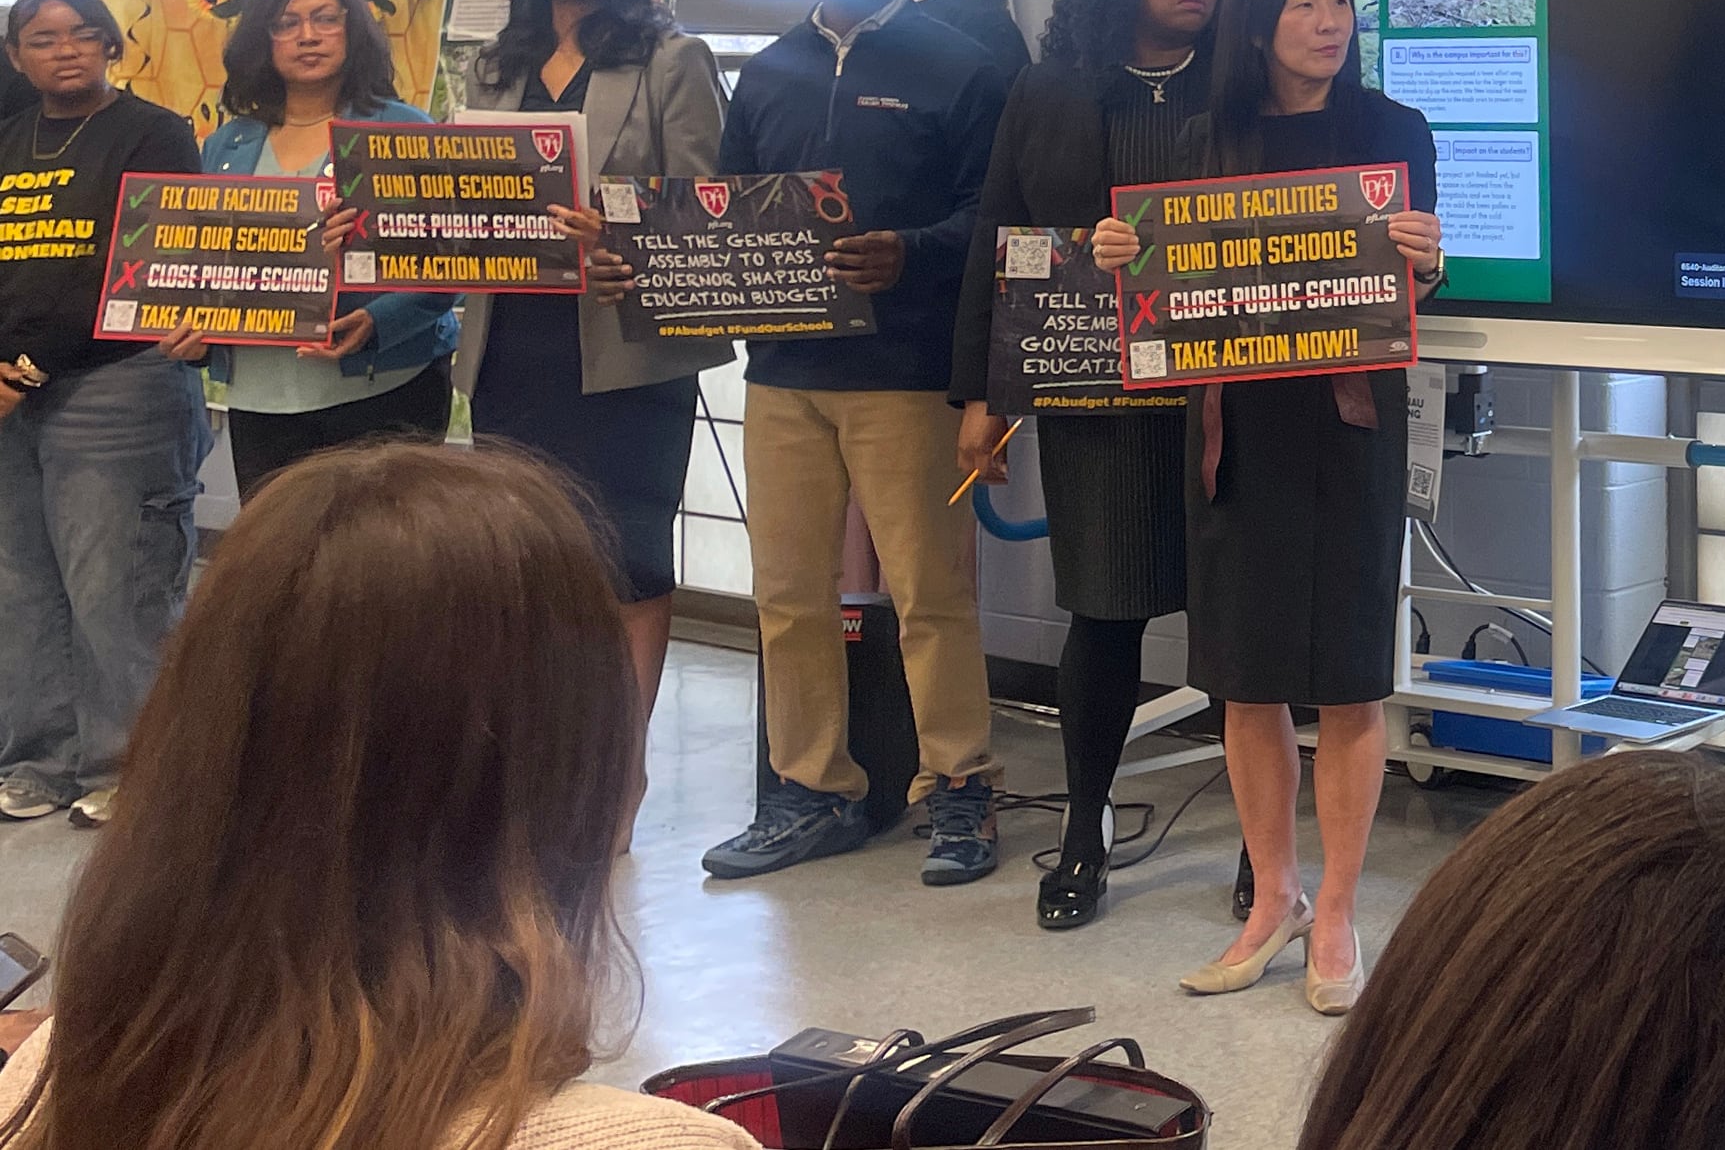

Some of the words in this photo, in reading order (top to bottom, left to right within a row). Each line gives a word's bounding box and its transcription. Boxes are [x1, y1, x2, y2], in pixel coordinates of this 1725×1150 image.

[368, 134, 393, 159] FIX
[395, 135, 430, 160] OUR
[433, 136, 517, 160] FACILITIES
[0, 169, 75, 192] DON'T
[372, 173, 417, 199] FUND
[420, 173, 456, 200] OUR
[458, 175, 535, 200] SCHOOLS
[0, 194, 53, 215] SELL
[160, 186, 184, 210] FIX
[186, 186, 220, 211] OUR
[223, 188, 299, 213] FACILITIES
[1163, 195, 1191, 226] FIX
[1196, 192, 1236, 222] OUR
[1242, 183, 1338, 220] FACILITIES
[0, 218, 96, 242] KENAU
[377, 213, 426, 239] CLOSE
[430, 214, 489, 239] PUBLIC
[154, 225, 198, 249] FUND
[199, 226, 233, 251] OUR
[236, 228, 307, 253] SCHOOLS
[632, 234, 680, 251] TELL
[683, 234, 720, 250] THE
[726, 229, 820, 248] GENERAL
[1166, 241, 1217, 273] FUND
[1221, 237, 1262, 269] OUR
[1267, 229, 1358, 265] SCHOOLS
[379, 255, 418, 280] TAKE
[422, 256, 480, 281] ACTION
[484, 256, 538, 281] NOW!!
[647, 252, 733, 269] ASSEMBLY
[739, 252, 766, 267] TO
[772, 249, 815, 266] PASS
[147, 263, 198, 289] CLOSE
[200, 265, 258, 291] PUBLIC
[259, 267, 329, 293] SCHOOLS
[633, 270, 737, 289] GOVERNOR
[742, 266, 830, 287] SHAPIRO'
[1681, 275, 1720, 287] Session
[640, 290, 746, 309] EDUCATION
[750, 285, 838, 305] BUDGET!
[1034, 293, 1086, 310] TELL
[1095, 293, 1119, 309] TH
[1168, 288, 1228, 321] CLOSE
[1232, 281, 1302, 316] PUBLIC
[1305, 273, 1398, 310] SCHOOLS
[140, 304, 180, 330] TAKE
[182, 306, 242, 333] ACTION
[243, 309, 296, 334] NOW!!
[659, 324, 725, 338] #PAbudget
[727, 320, 834, 335] #FundOurSchools
[1043, 315, 1119, 332] ASSEMB
[1020, 335, 1122, 354] GOVERNO
[1171, 339, 1218, 371] TAKE
[1222, 334, 1291, 369] ACTION
[1296, 328, 1359, 364] NOW!!
[1033, 397, 1109, 410] #PAbudget
[1113, 396, 1187, 408] #FundOurS
